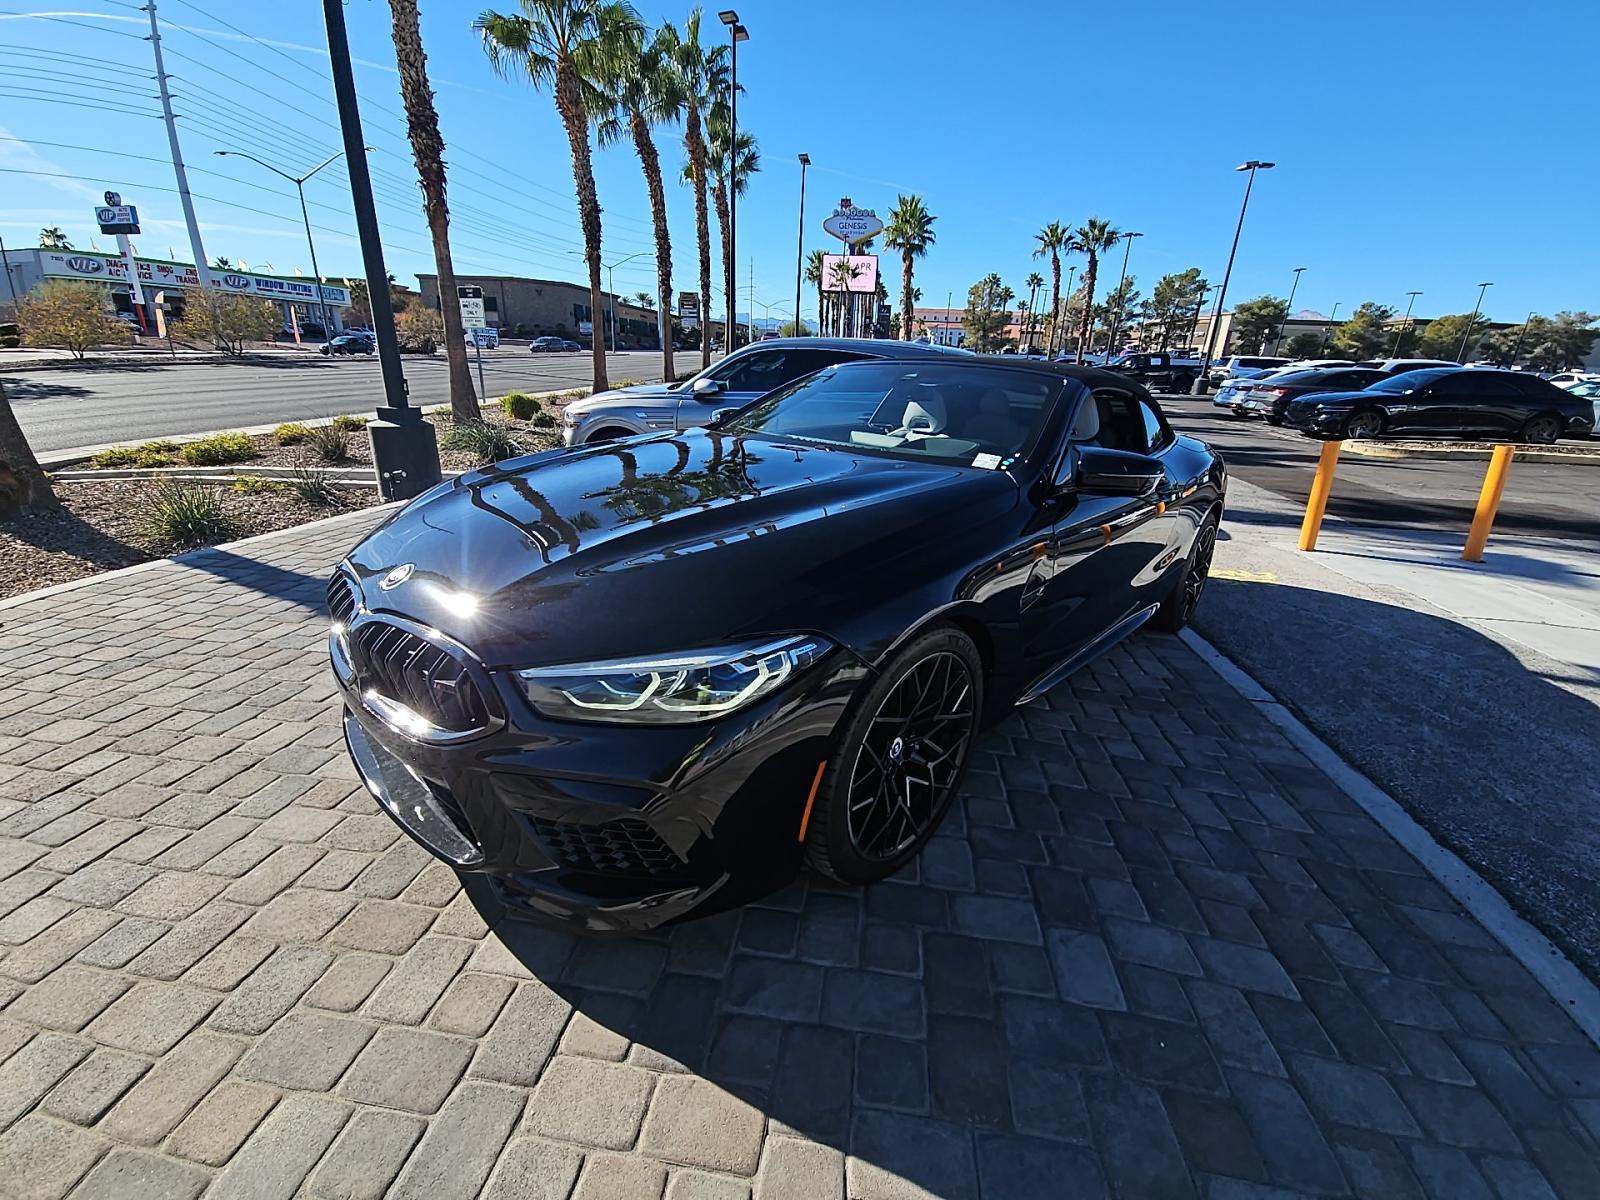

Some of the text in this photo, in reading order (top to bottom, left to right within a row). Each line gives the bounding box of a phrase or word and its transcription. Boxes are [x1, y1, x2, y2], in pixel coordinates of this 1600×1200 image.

[99, 210, 115, 221] VIP
[839, 222, 867, 230] GENESIS
[69, 257, 99, 273] VIP
[226, 275, 248, 288] VIP
[254, 278, 285, 290] WINDOW
[286, 283, 312, 293] TINTING
